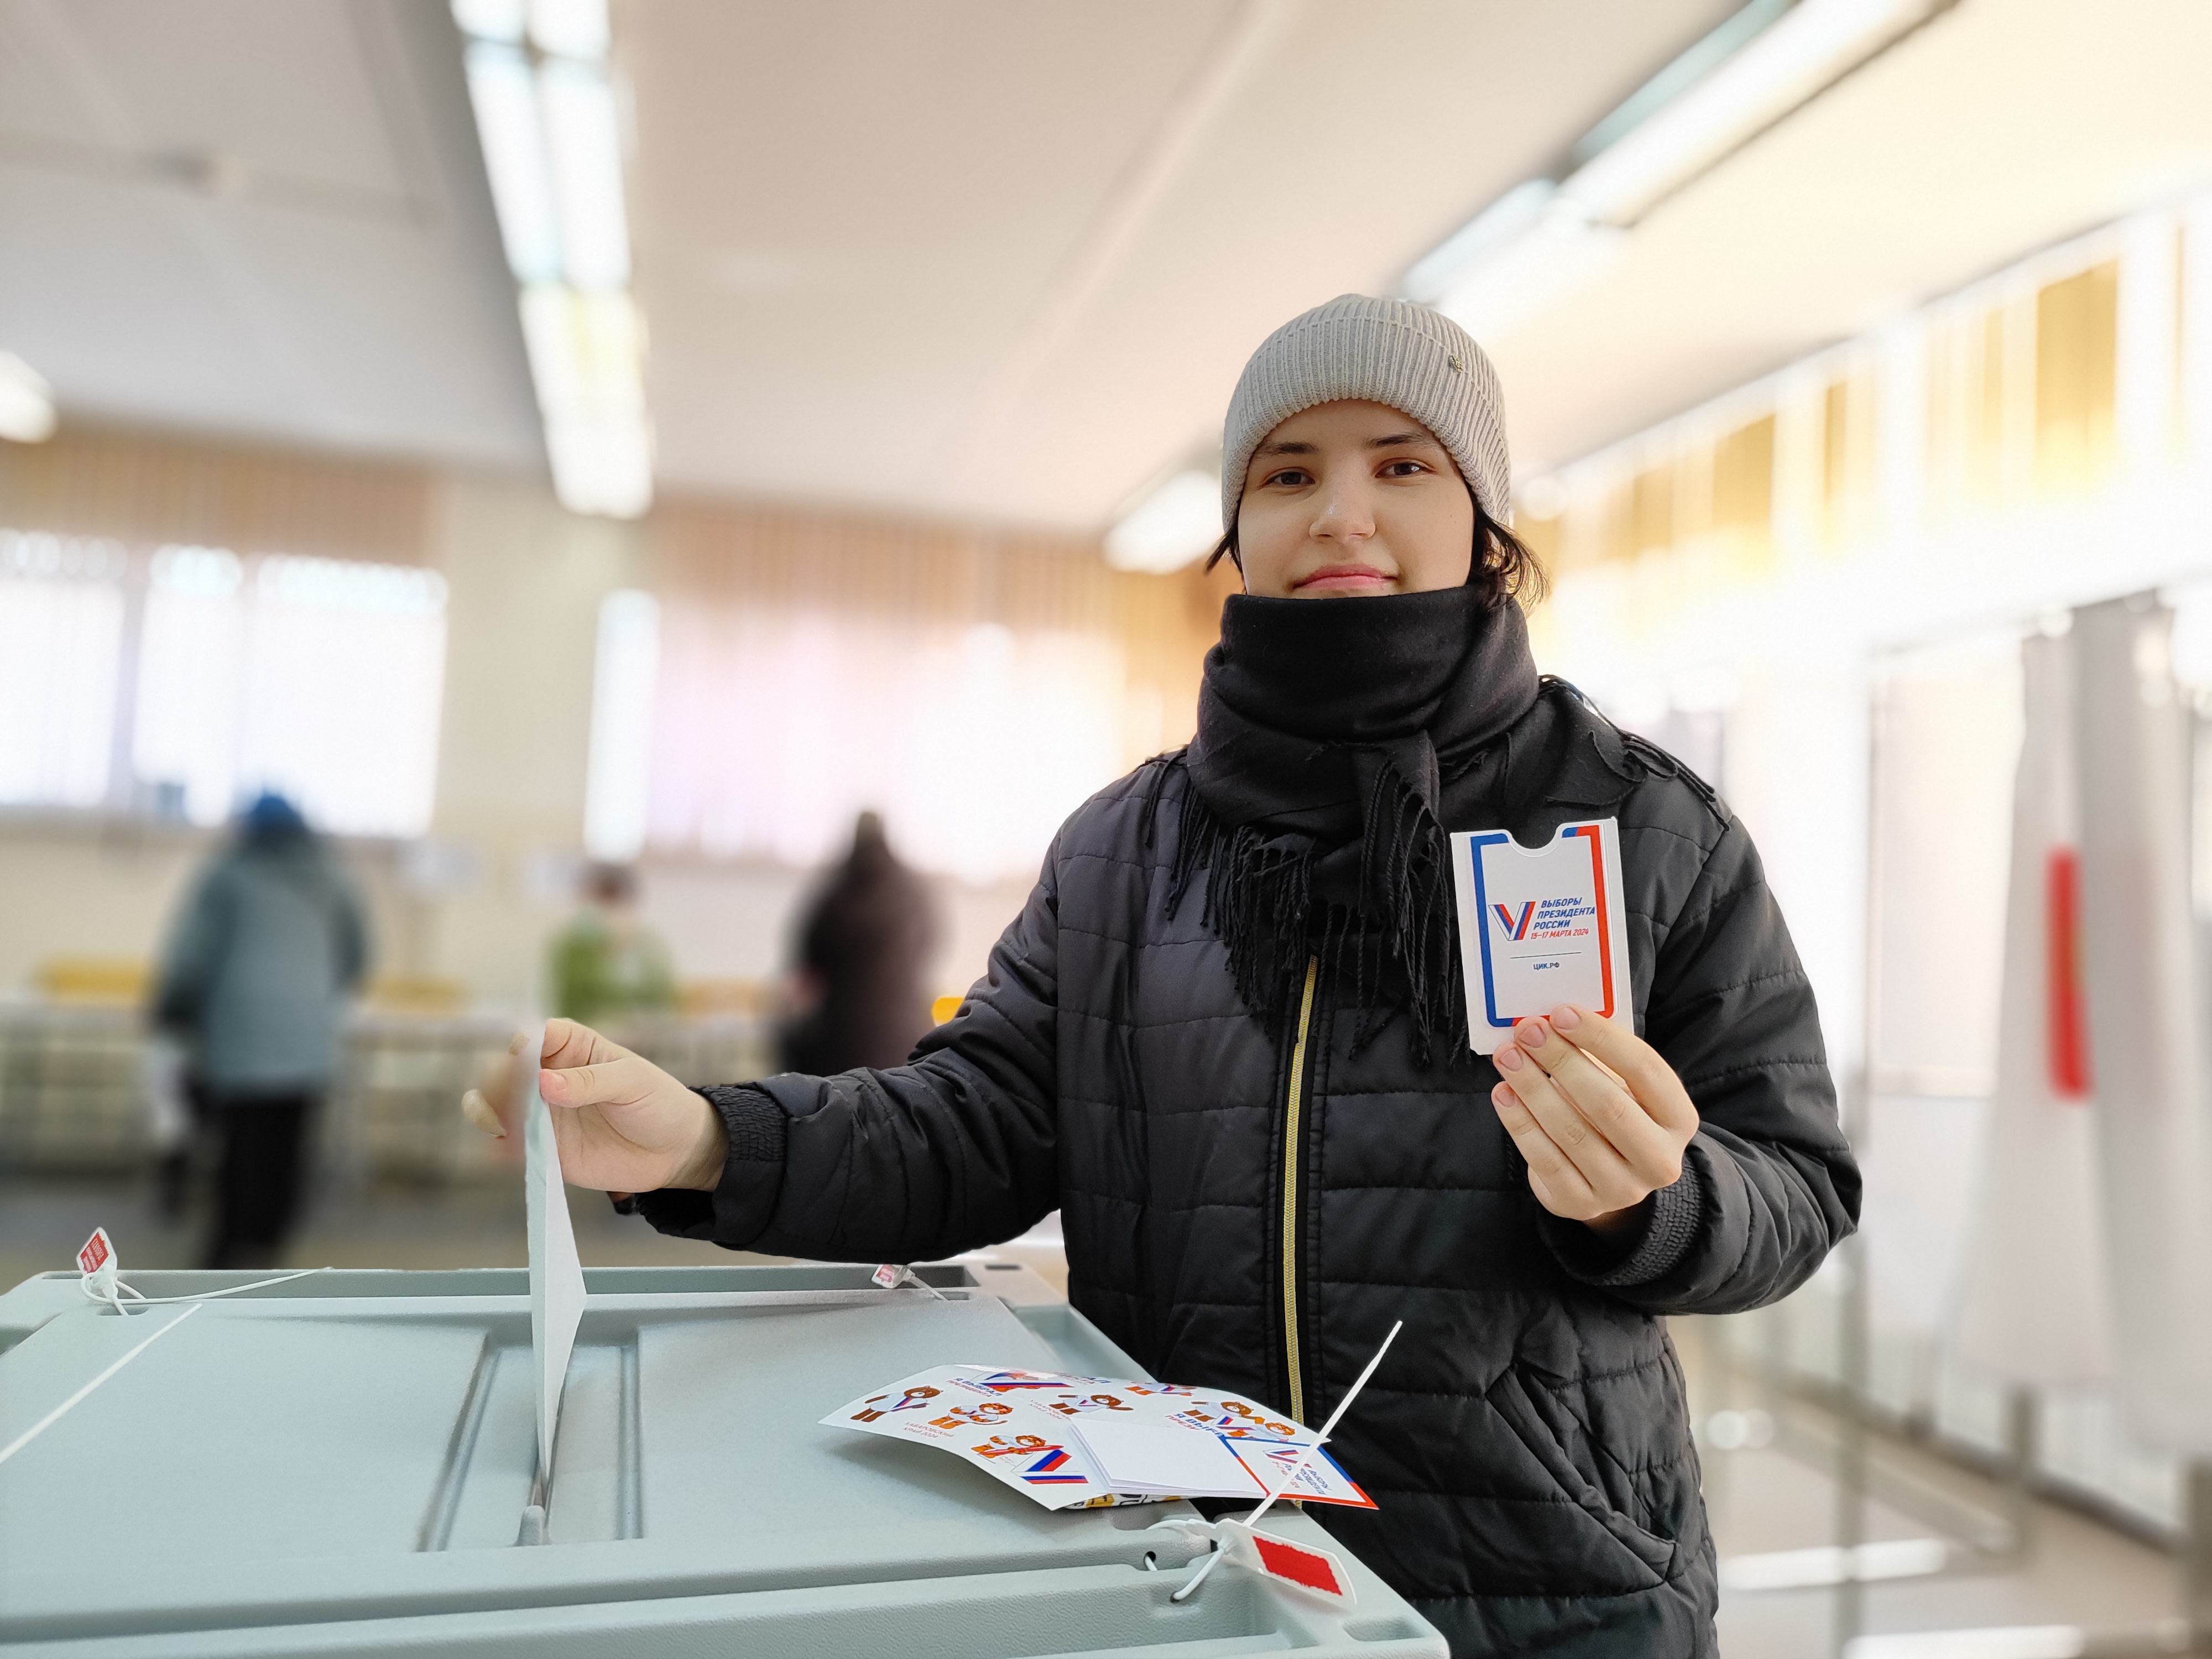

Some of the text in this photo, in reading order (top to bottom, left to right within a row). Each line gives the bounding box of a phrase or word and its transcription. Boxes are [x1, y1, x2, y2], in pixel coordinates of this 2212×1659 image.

[1541, 897, 1583, 908] ВЫБОРЫ
[1537, 907, 1595, 919] ПРЕЗИДЕНТА
[1533, 919, 1571, 930] РОССИИ
[1549, 930, 1572, 938] МАРТА
[1572, 928, 1589, 936] 2024
